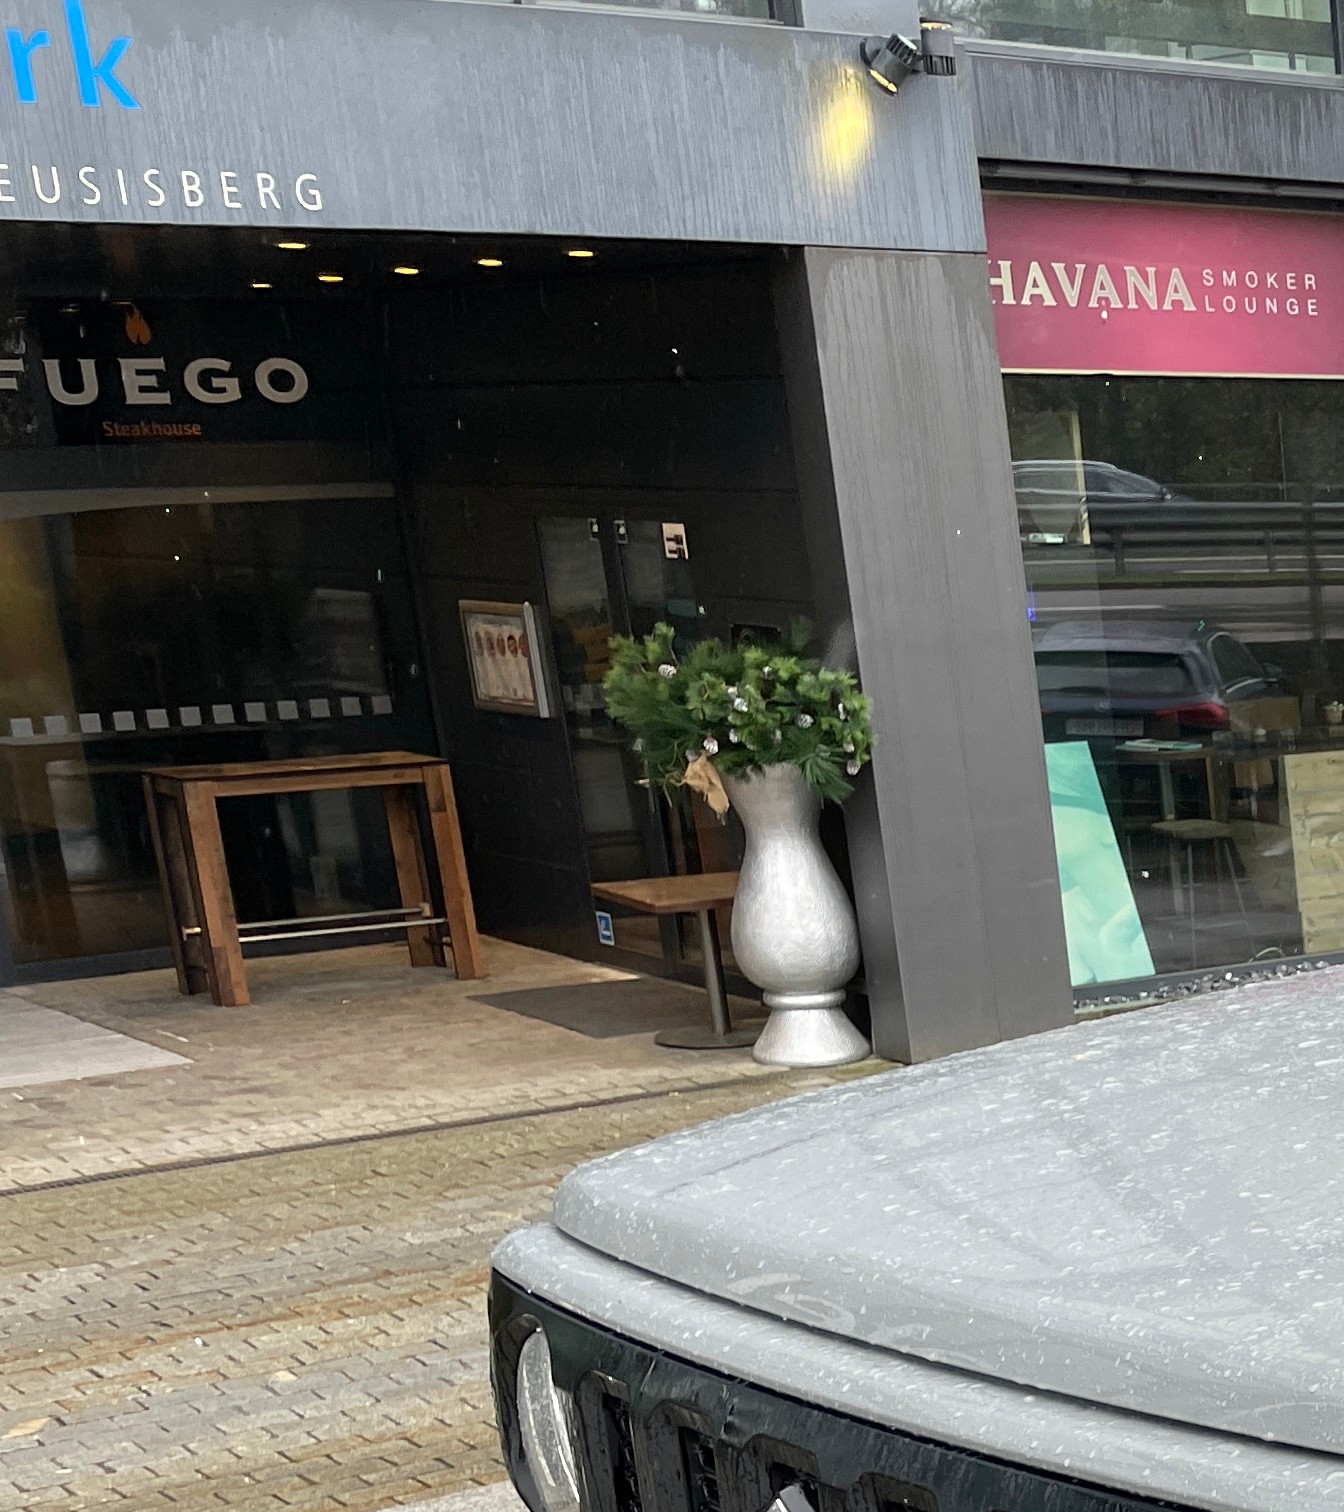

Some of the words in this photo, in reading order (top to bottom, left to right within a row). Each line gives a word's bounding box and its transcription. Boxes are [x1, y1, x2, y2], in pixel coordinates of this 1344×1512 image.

[5, 0, 142, 110] rk
[988, 260, 1197, 311] HAVANA
[1202, 268, 1317, 291] SMOKER
[1204, 295, 1319, 316] LOUNGE
[102, 421, 202, 438] Steakhouse
